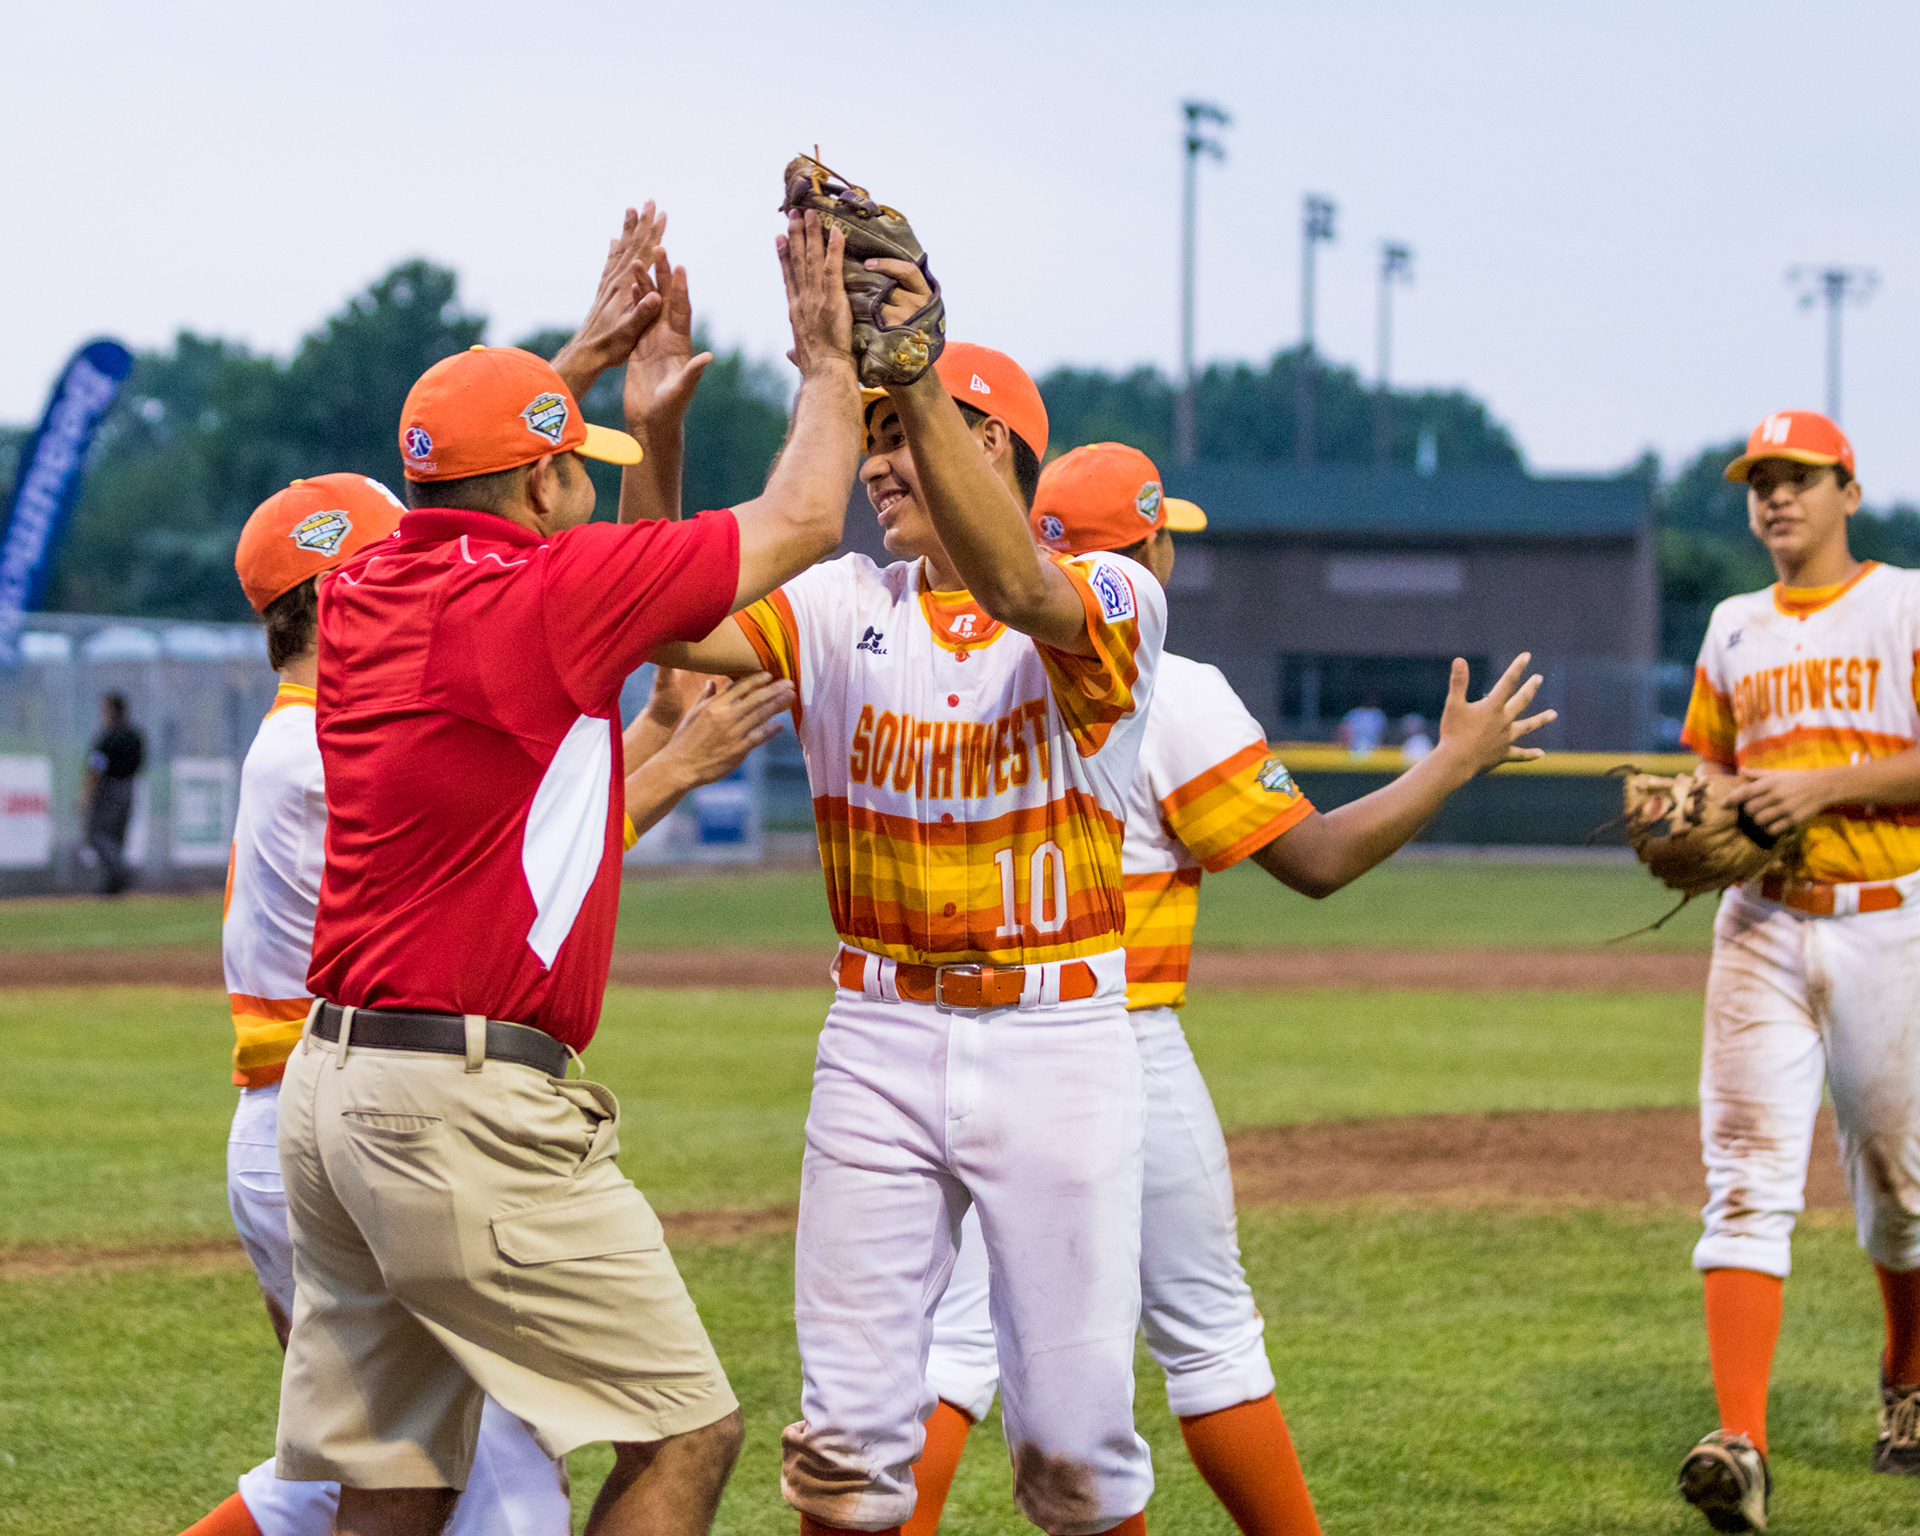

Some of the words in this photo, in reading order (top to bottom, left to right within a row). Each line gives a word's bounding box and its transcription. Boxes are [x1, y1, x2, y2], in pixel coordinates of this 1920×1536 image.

[1733, 659, 1881, 730] SOUTHWEST
[849, 698, 1049, 799] SOUTHWEST
[993, 841, 1068, 938] 10
